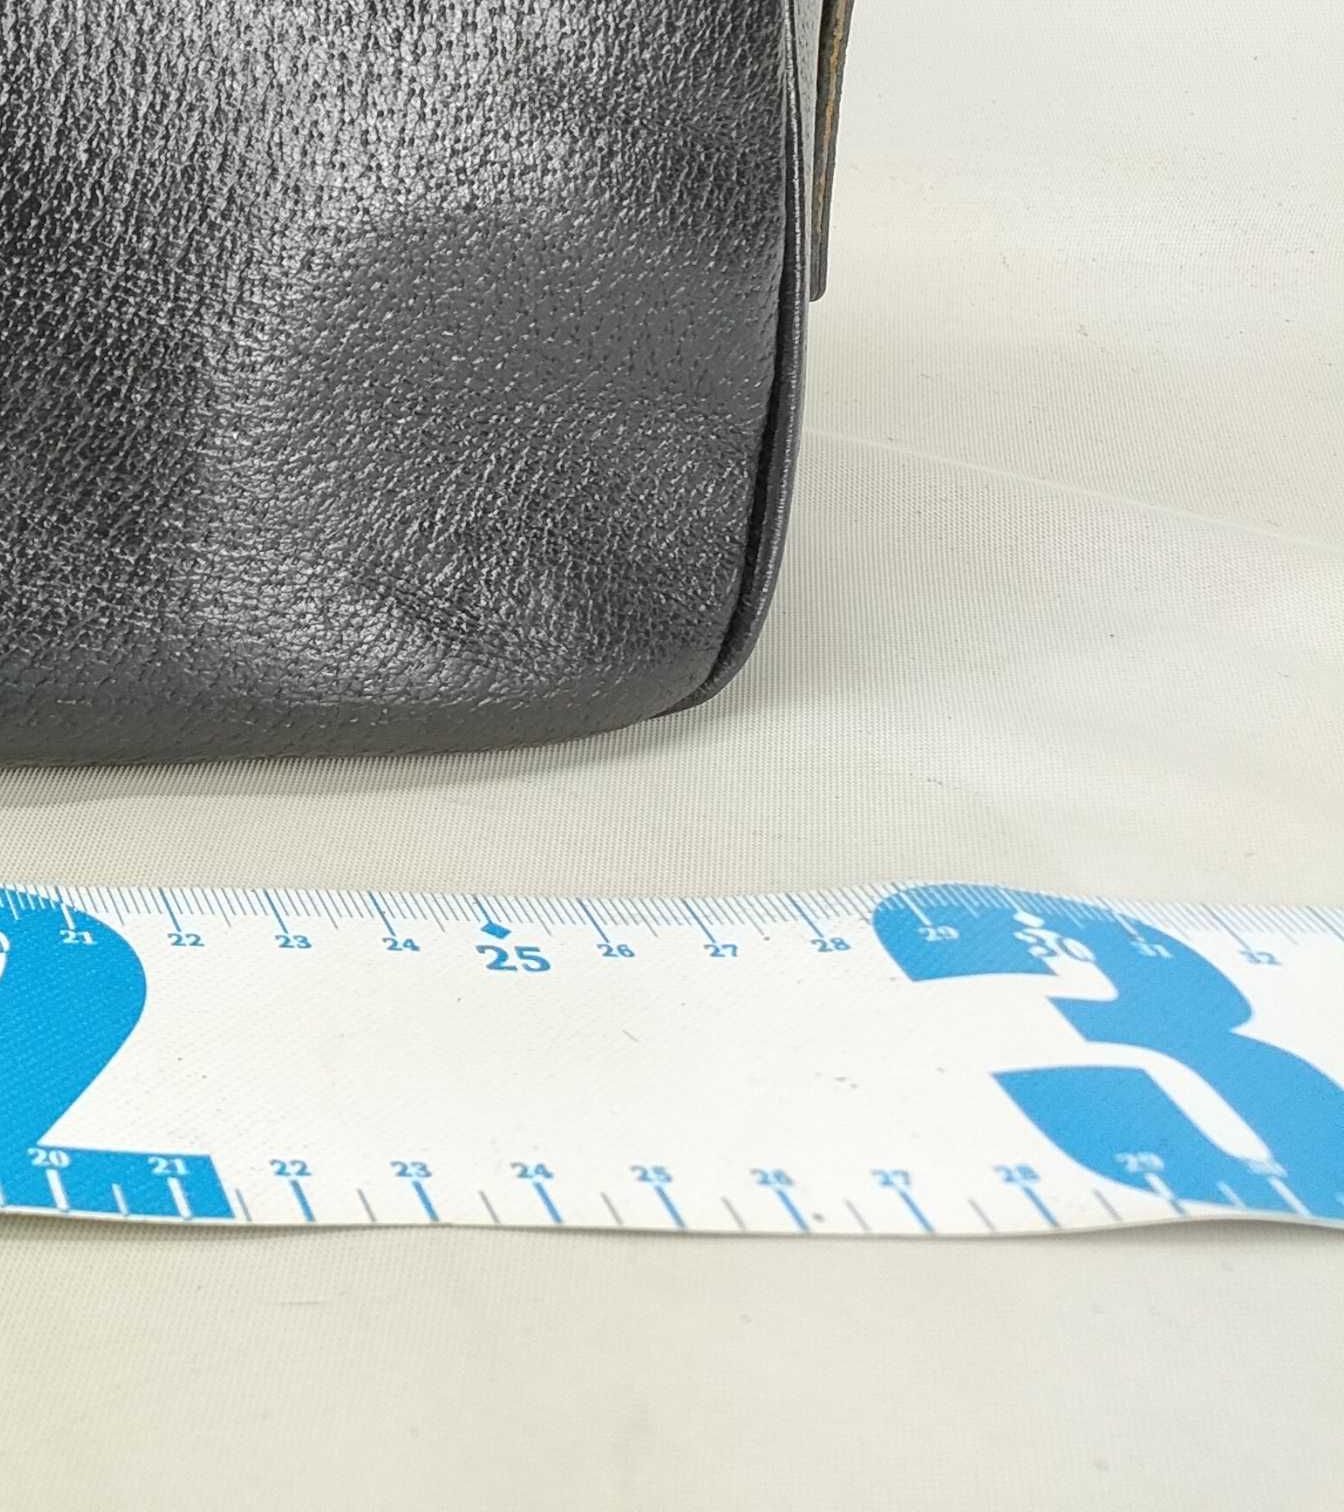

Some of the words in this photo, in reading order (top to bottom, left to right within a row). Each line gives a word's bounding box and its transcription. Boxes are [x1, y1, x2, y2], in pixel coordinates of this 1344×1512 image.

[59, 929, 94, 946] 21
[168, 932, 205, 949] 22
[274, 934, 312, 950] 23
[381, 937, 420, 952] 24
[476, 945, 551, 973] 25
[597, 943, 636, 959] 26
[704, 943, 739, 958] 27
[810, 938, 851, 953] 28
[872, 883, 1344, 1221] 3
[26, 1148, 71, 1169] 20
[146, 1156, 188, 1177] 21
[269, 1159, 312, 1178] 22
[390, 1161, 432, 1179] 23
[510, 1163, 554, 1180] 24
